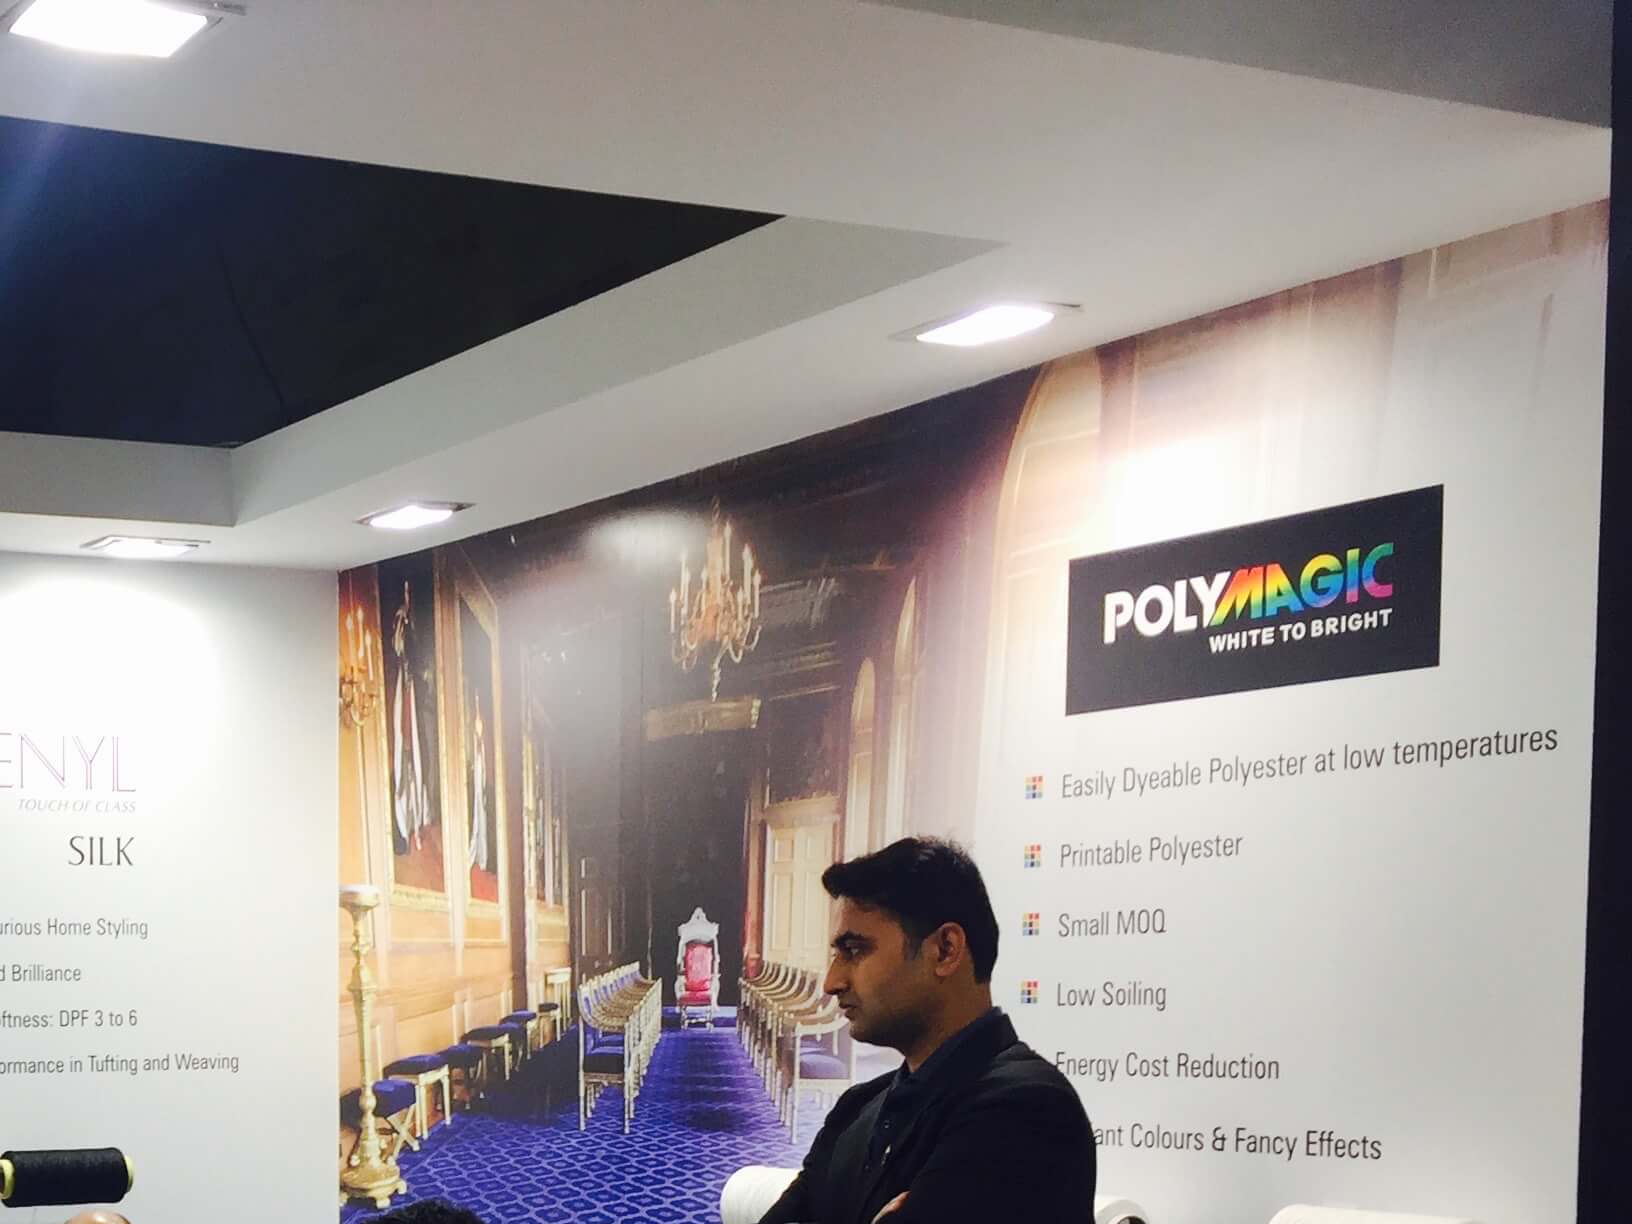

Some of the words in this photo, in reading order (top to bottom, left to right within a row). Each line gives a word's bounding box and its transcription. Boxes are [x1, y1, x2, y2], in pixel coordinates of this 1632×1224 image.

[1103, 542, 1395, 645] POLYMAGIC
[1209, 626, 1275, 654] WHITE
[1279, 621, 1306, 643] TO
[1311, 608, 1393, 638] BRIGHT
[1061, 771, 1116, 800] Easily
[1122, 762, 1202, 797] Dyeable
[1209, 751, 1307, 787] Polyester
[1314, 747, 1336, 773] at
[1343, 743, 1385, 769] low
[1392, 728, 1558, 768] temperatures
[17, 798, 69, 812] TOUCH
[95, 799, 137, 813] CLASS
[68, 835, 135, 866] SILK
[1059, 838, 1143, 868] Printable
[1149, 833, 1244, 866] Polyester
[47, 919, 91, 935] Home
[96, 919, 148, 939] Styling
[1058, 911, 1109, 938] Small
[1117, 908, 1167, 934] MOQ
[11, 964, 82, 982] Brilliance
[1056, 983, 1096, 1007] Low
[1102, 981, 1167, 1012] Soiling
[59, 1010, 89, 1027] DPF
[94, 1009, 103, 1027] 3
[109, 1010, 123, 1027] to
[128, 1009, 138, 1027] 6
[70, 1057, 83, 1073] in
[88, 1055, 138, 1075] Tufting
[143, 1054, 169, 1071] and
[175, 1054, 239, 1074] Weaving
[1055, 1051, 1119, 1082] Energy
[1125, 1051, 1169, 1078] Cost
[1176, 1052, 1280, 1079] Reduction
[1130, 1123, 1204, 1151] Colours
[1212, 1126, 1226, 1152] &
[1235, 1128, 1297, 1161] Fancy
[1305, 1130, 1383, 1160] Effects
